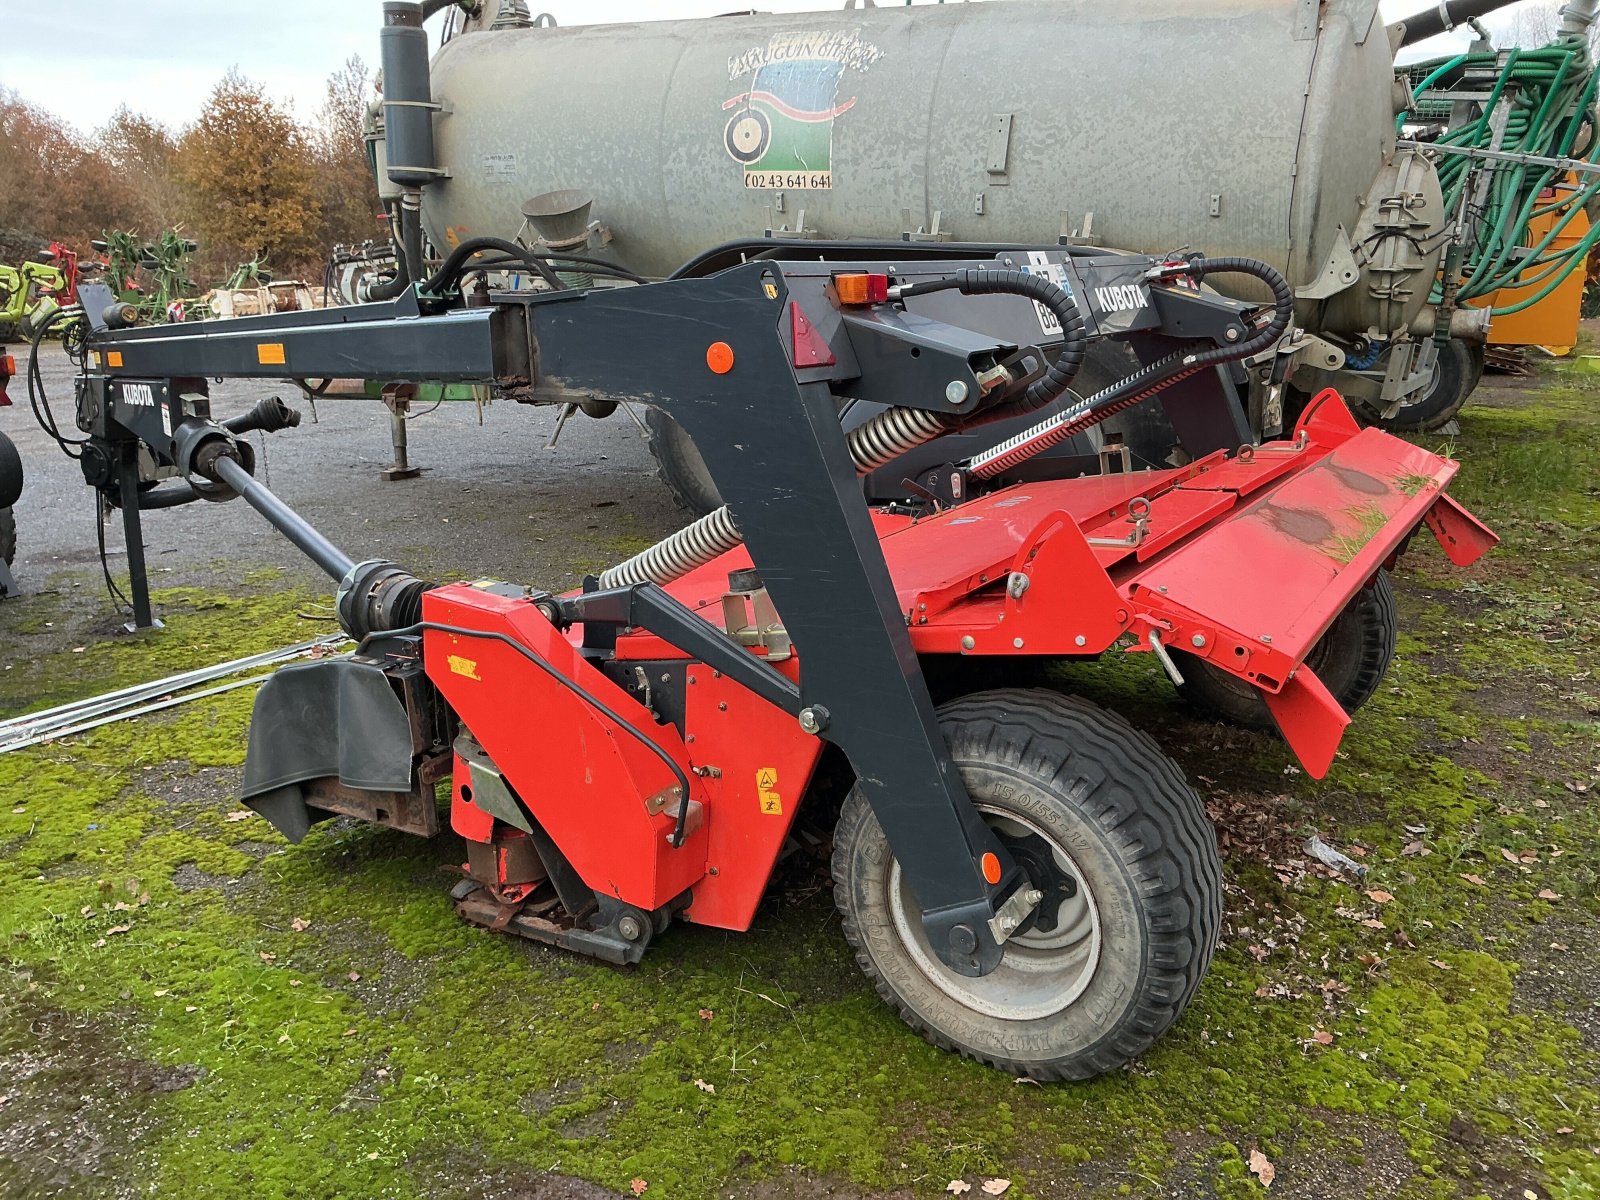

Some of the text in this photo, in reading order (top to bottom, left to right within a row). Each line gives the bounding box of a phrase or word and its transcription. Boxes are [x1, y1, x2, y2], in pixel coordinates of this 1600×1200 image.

[768, 174, 783, 188] 43
[787, 175, 807, 188] 641
[811, 175, 831, 189] 641
[1094, 284, 1149, 313] KUBOTA
[122, 383, 155, 407] KUBOTA
